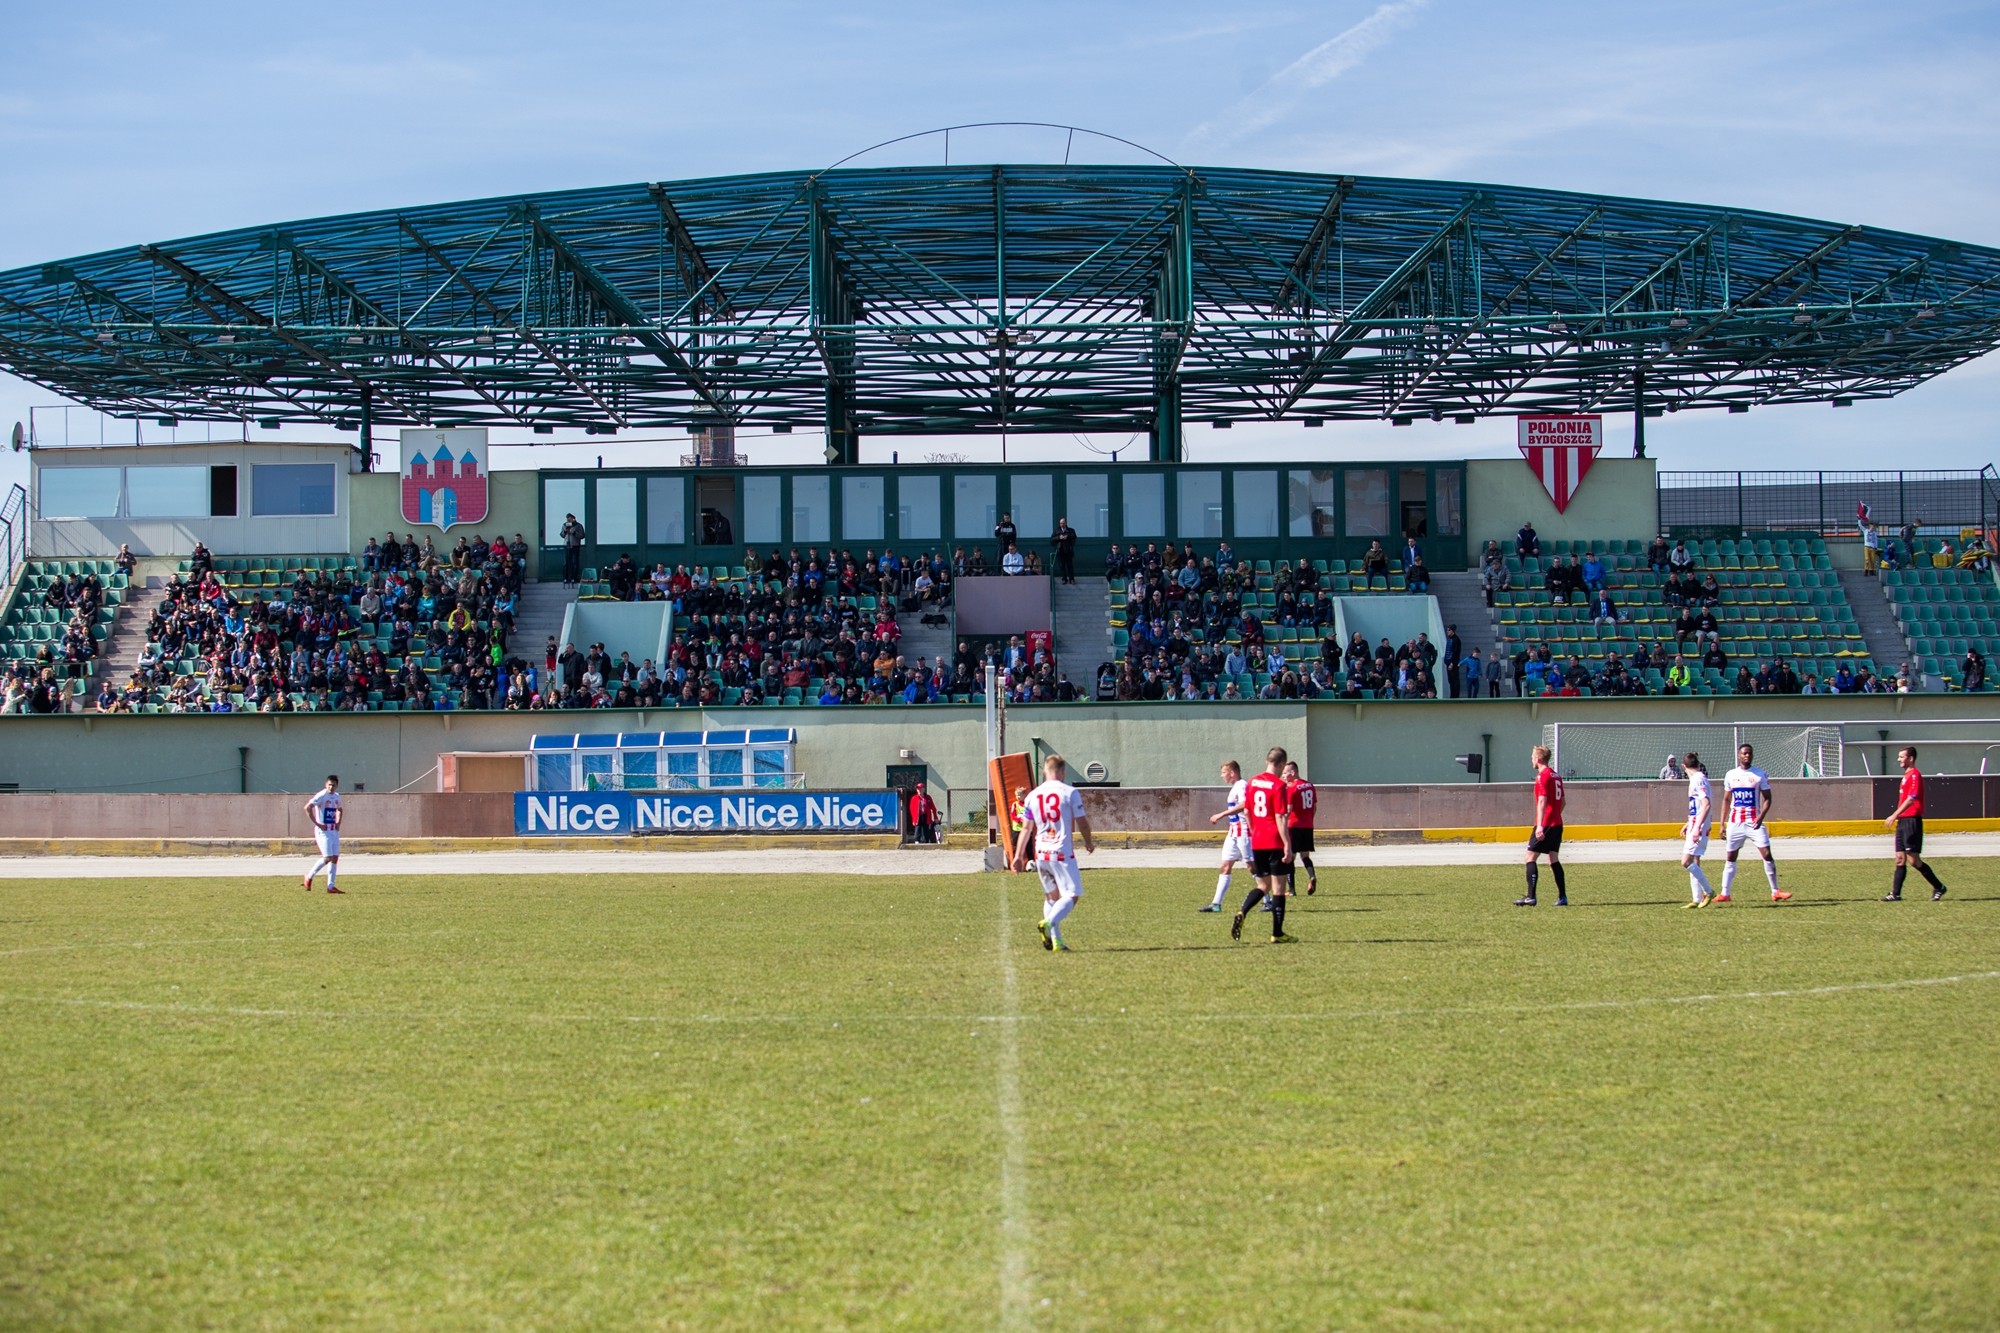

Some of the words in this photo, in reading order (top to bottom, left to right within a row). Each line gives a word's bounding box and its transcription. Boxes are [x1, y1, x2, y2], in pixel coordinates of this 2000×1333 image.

[1528, 422, 1592, 434] POLONIA
[1528, 435, 1592, 444] BYDGOSZCZ
[1301, 789, 1314, 810] 18
[1555, 780, 1562, 800] 6
[527, 795, 620, 831] Nice
[636, 798, 715, 828] Nice
[721, 797, 799, 827] Nice
[805, 796, 884, 827] Nice
[1037, 793, 1061, 823] 13
[1253, 790, 1267, 818] 8
